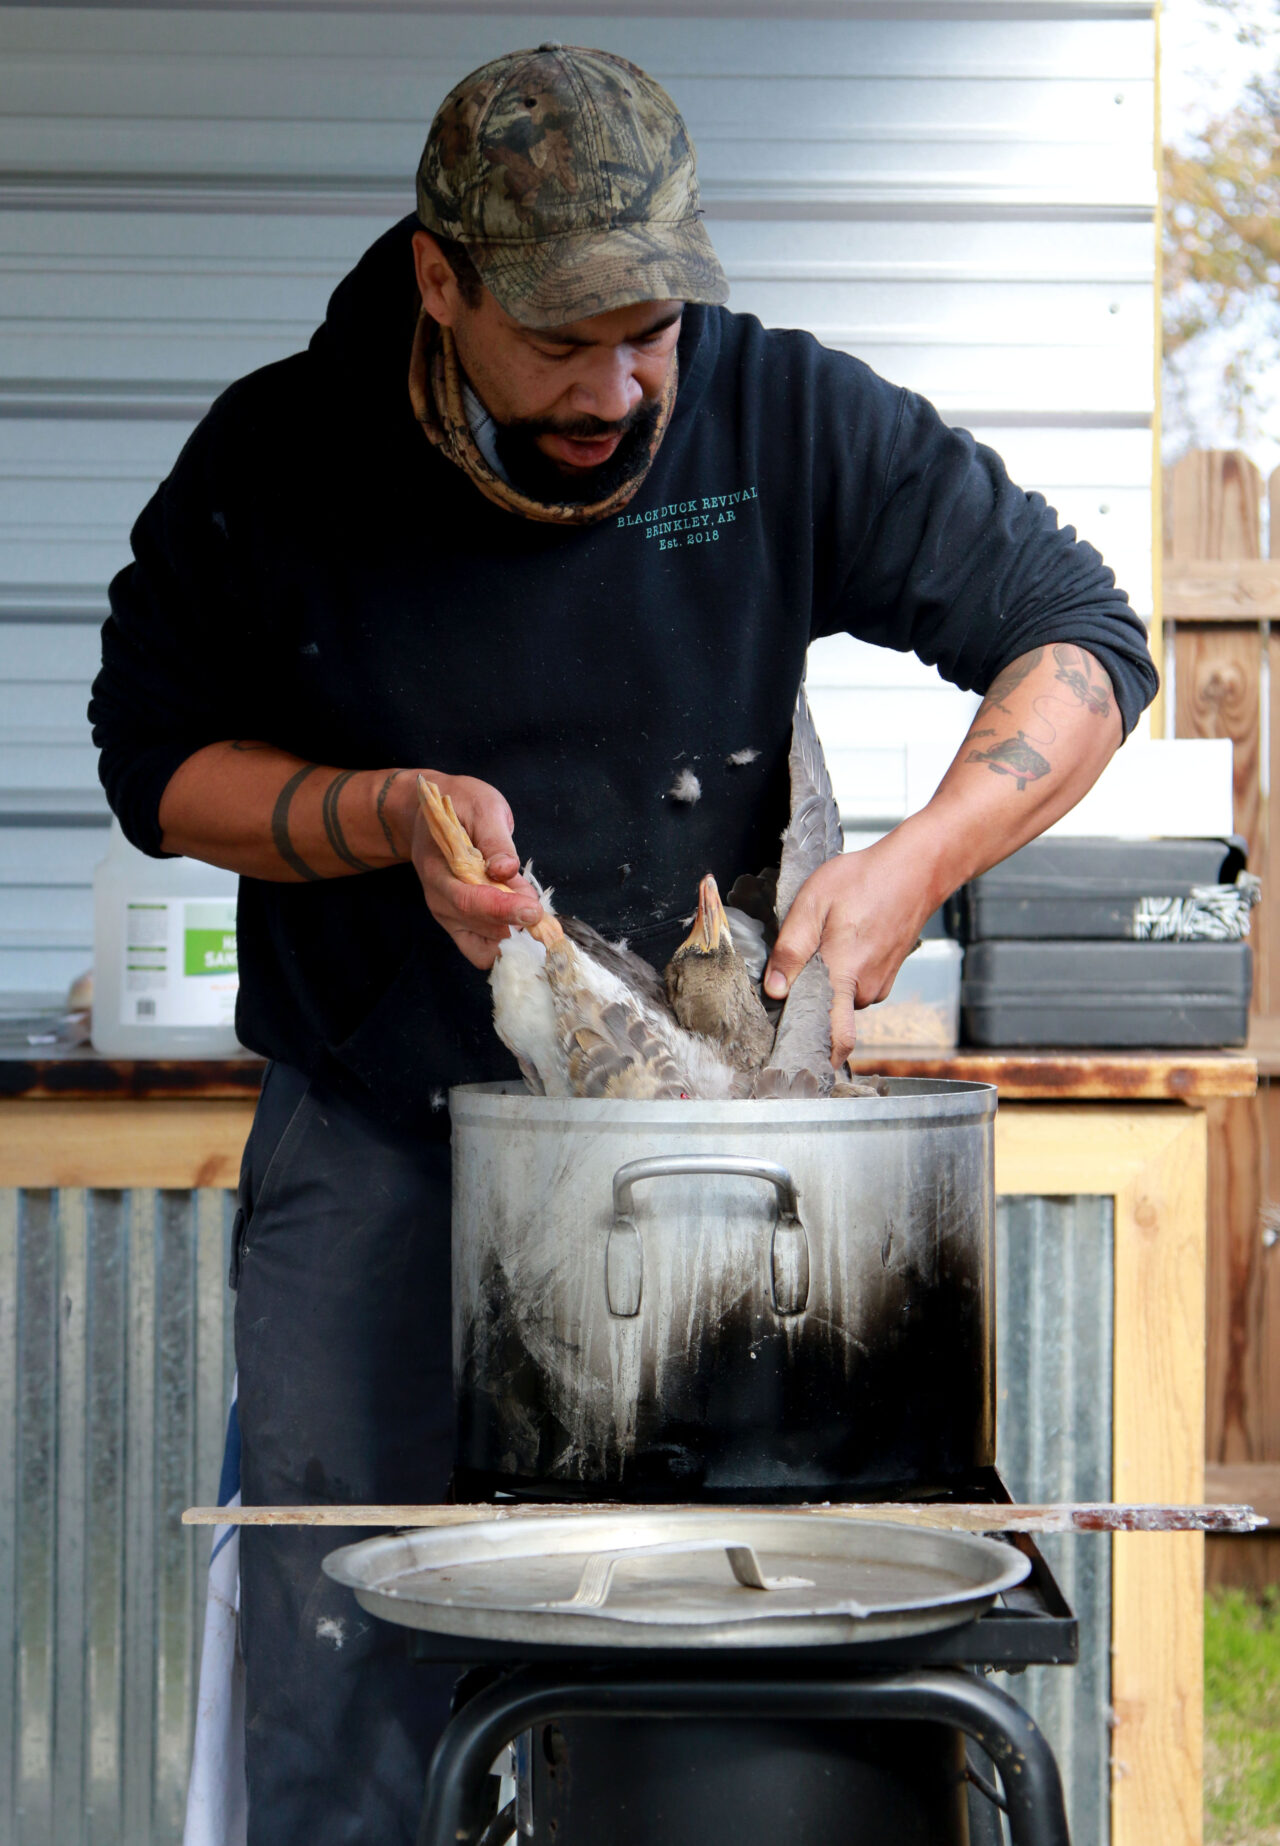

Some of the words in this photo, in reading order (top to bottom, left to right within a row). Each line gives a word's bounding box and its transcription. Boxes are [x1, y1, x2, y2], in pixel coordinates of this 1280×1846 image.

[617, 500, 697, 528] BLACKDUCK
[702, 487, 758, 509] REVIVAL
[646, 515, 714, 539] BRINKLEY,
[717, 511, 736, 523] AR
[659, 539, 682, 550] Est.
[687, 530, 719, 544] 2018
